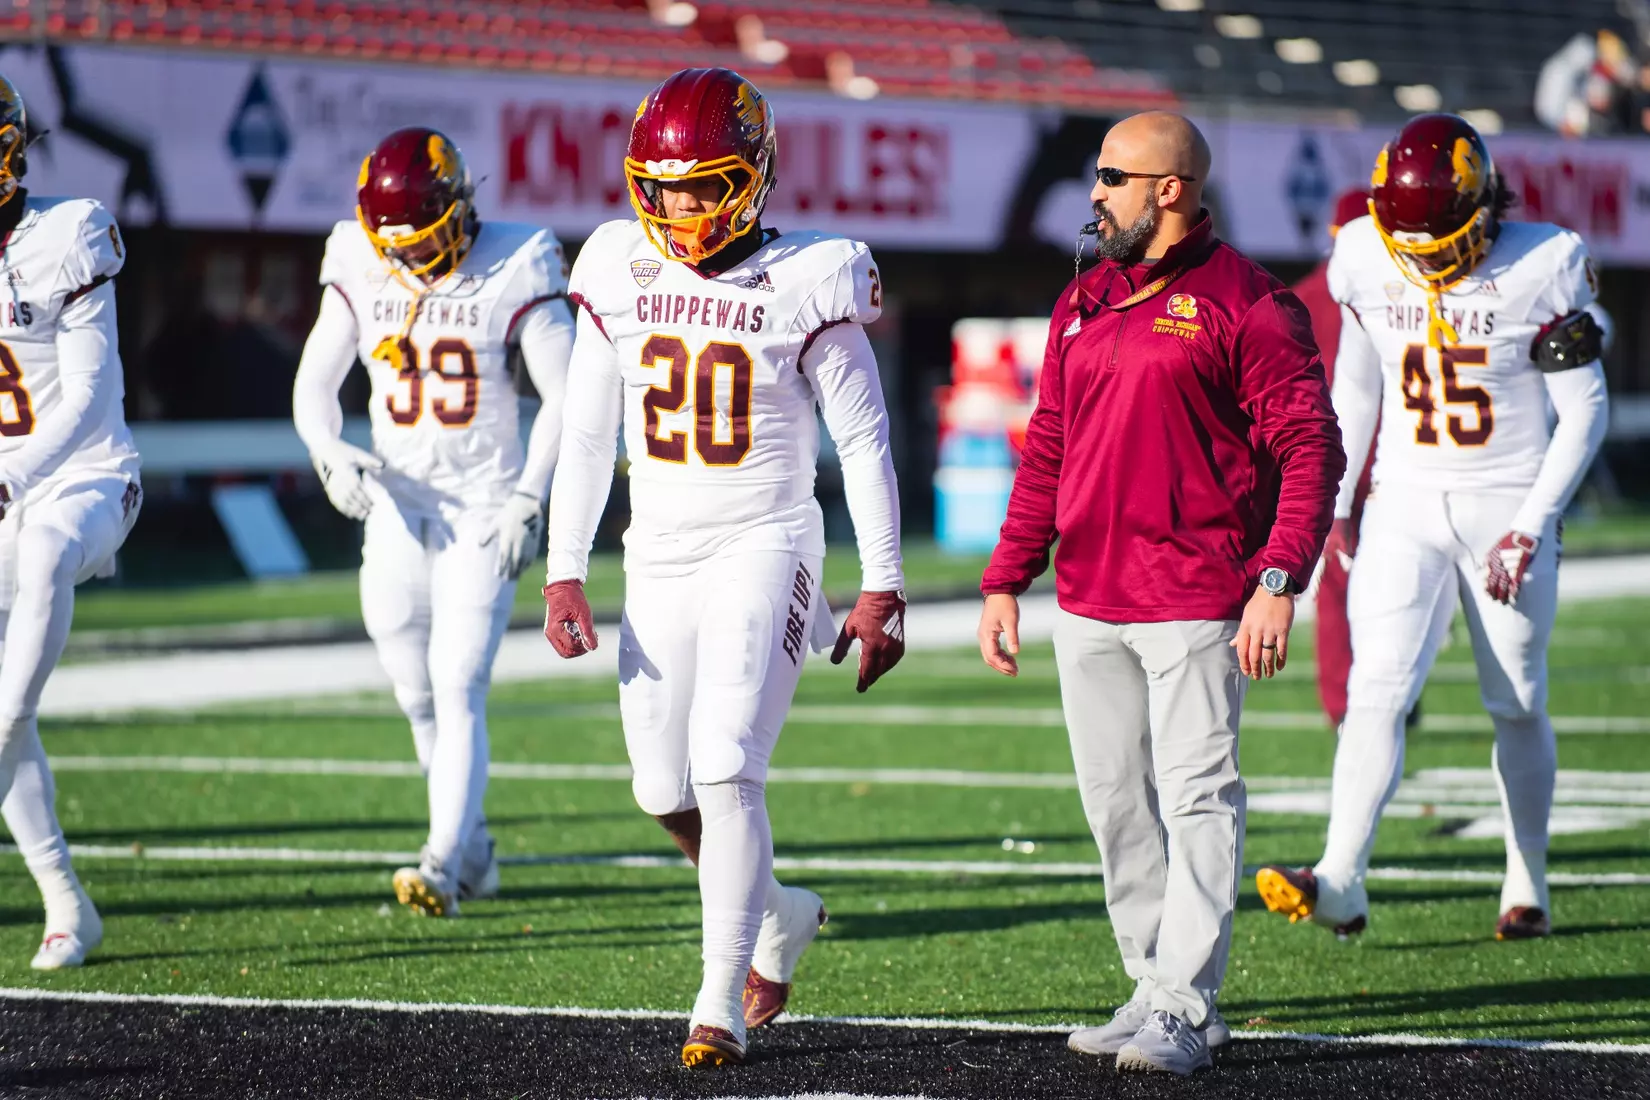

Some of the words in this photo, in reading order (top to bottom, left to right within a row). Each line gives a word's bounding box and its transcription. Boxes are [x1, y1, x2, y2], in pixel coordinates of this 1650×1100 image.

[632, 267, 660, 277] MAC
[745, 275, 776, 293] addas
[868, 268, 883, 308] 2
[636, 293, 766, 334] CHIPPEWAS
[1387, 305, 1495, 335] CHIPEWAS
[384, 335, 481, 429] 39
[639, 333, 755, 468] 20
[1401, 342, 1496, 448] 45
[792, 560, 815, 612] UP!
[782, 602, 806, 668] FIRE
